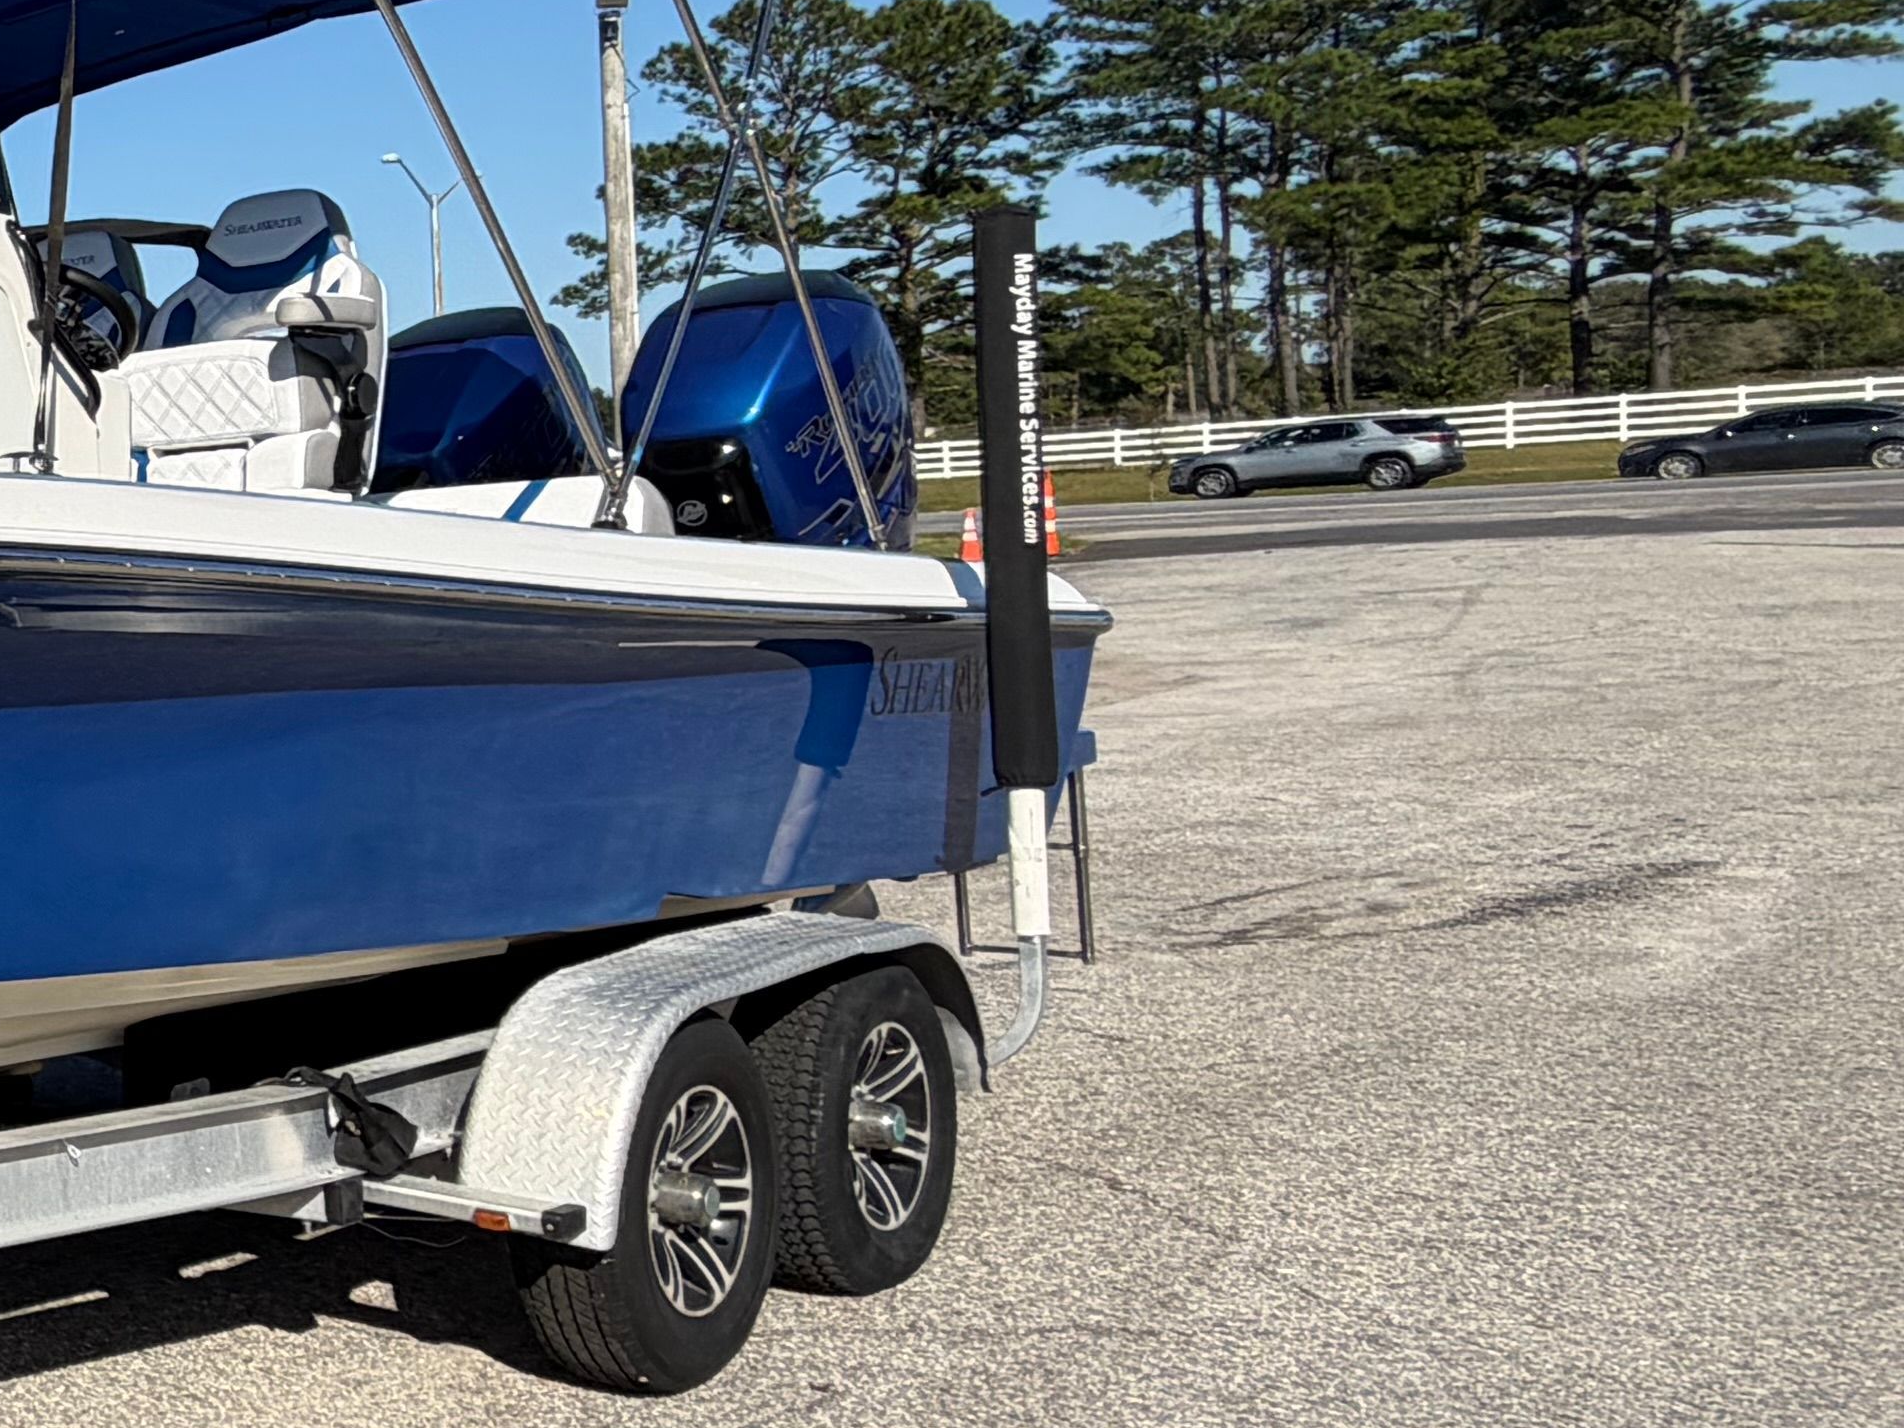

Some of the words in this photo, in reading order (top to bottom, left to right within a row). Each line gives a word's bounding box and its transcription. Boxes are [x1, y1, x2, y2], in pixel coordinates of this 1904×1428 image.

[1009, 253, 1035, 336] Mayday
[1017, 340, 1037, 415] Marine
[1019, 418, 1041, 545] Services.com
[870, 645, 989, 717] SHEARW
